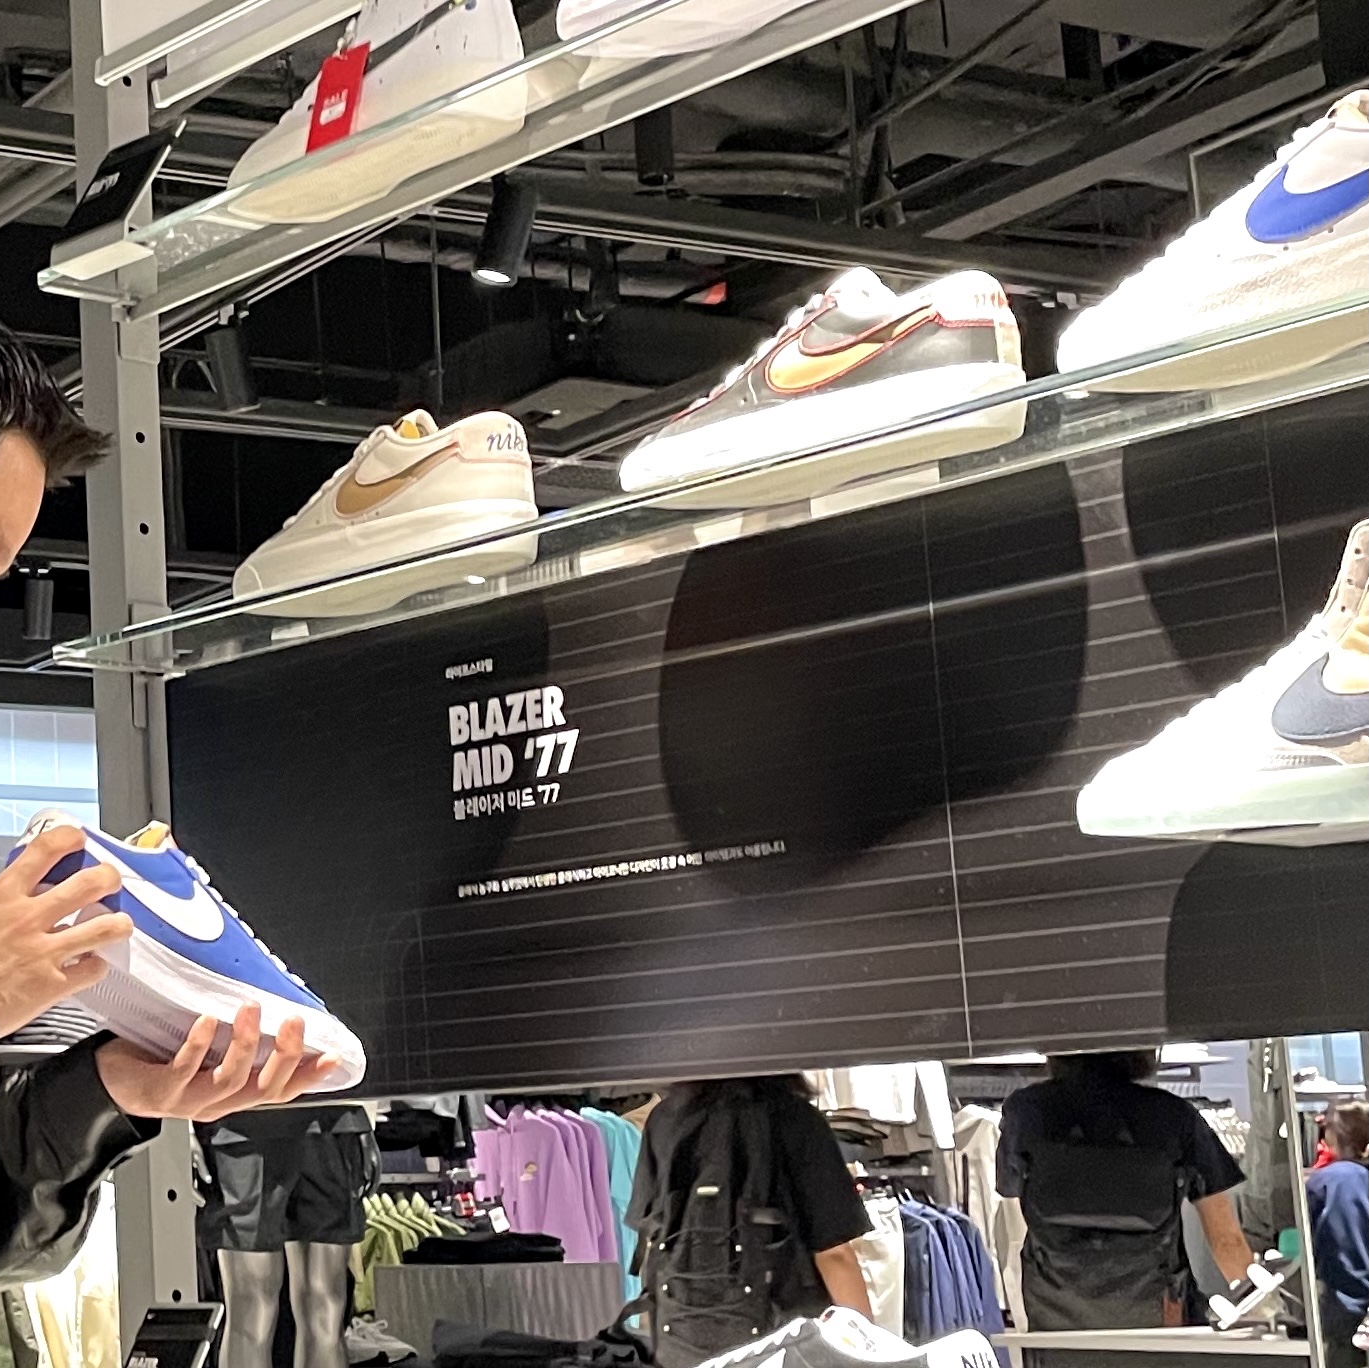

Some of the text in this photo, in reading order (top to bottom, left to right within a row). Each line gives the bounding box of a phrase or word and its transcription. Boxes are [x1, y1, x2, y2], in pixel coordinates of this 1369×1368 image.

[486, 423, 525, 452] nik
[448, 685, 567, 747] BLAZER
[452, 743, 514, 792] MID
[507, 787, 536, 811] 미드
